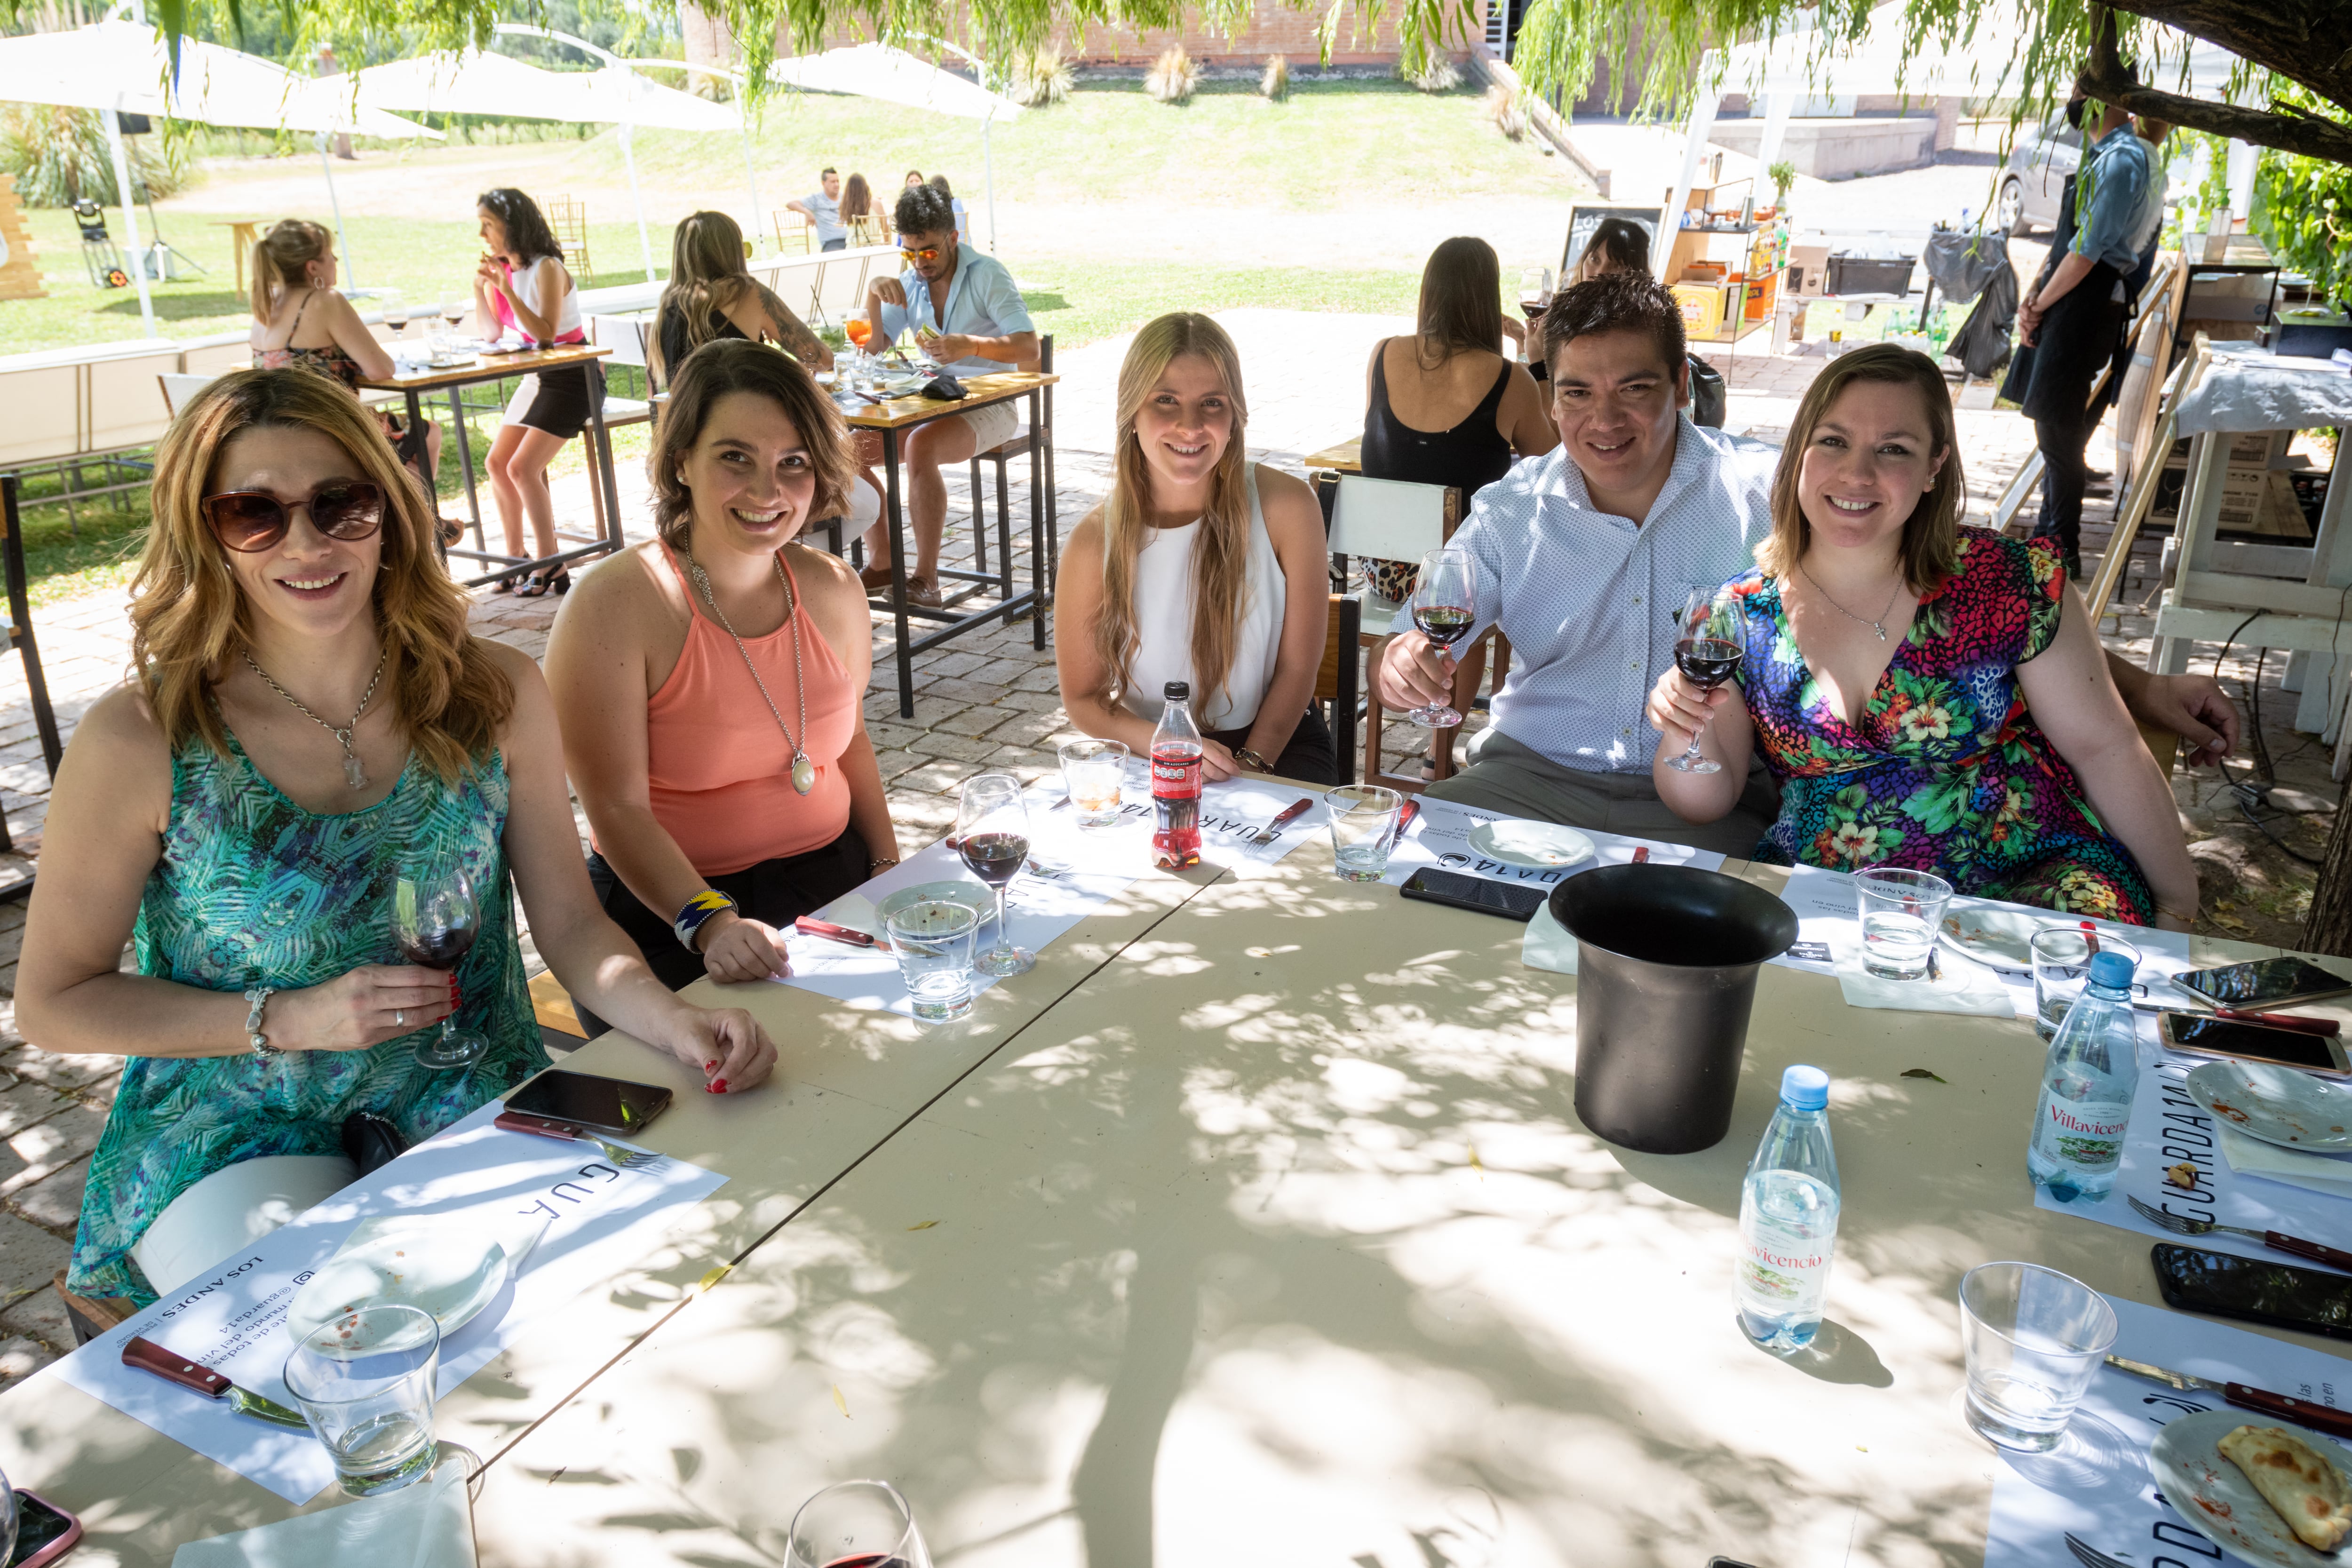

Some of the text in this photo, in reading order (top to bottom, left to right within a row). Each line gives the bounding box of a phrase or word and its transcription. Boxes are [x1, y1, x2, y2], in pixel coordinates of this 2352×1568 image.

[1747, 288, 1760, 298] ROL
[2051, 1104, 2129, 1135] Villavicenc
[2161, 1085, 2216, 1224] GUARDA1
[1739, 1231, 1821, 1269] illavicencio
[227, 1256, 264, 1279] LOS
[162, 1278, 224, 1319] ANDES
[218, 1286, 292, 1334] @guarda14
[246, 1304, 290, 1332] mundo
[116, 1327, 144, 1345] VERDAD
[219, 1331, 241, 1349] del
[253, 1328, 270, 1340] de
[194, 1349, 220, 1366] vin
[213, 1341, 252, 1366] todas
[2297, 1383, 2312, 1399] las
[2322, 1383, 2333, 1395] en
